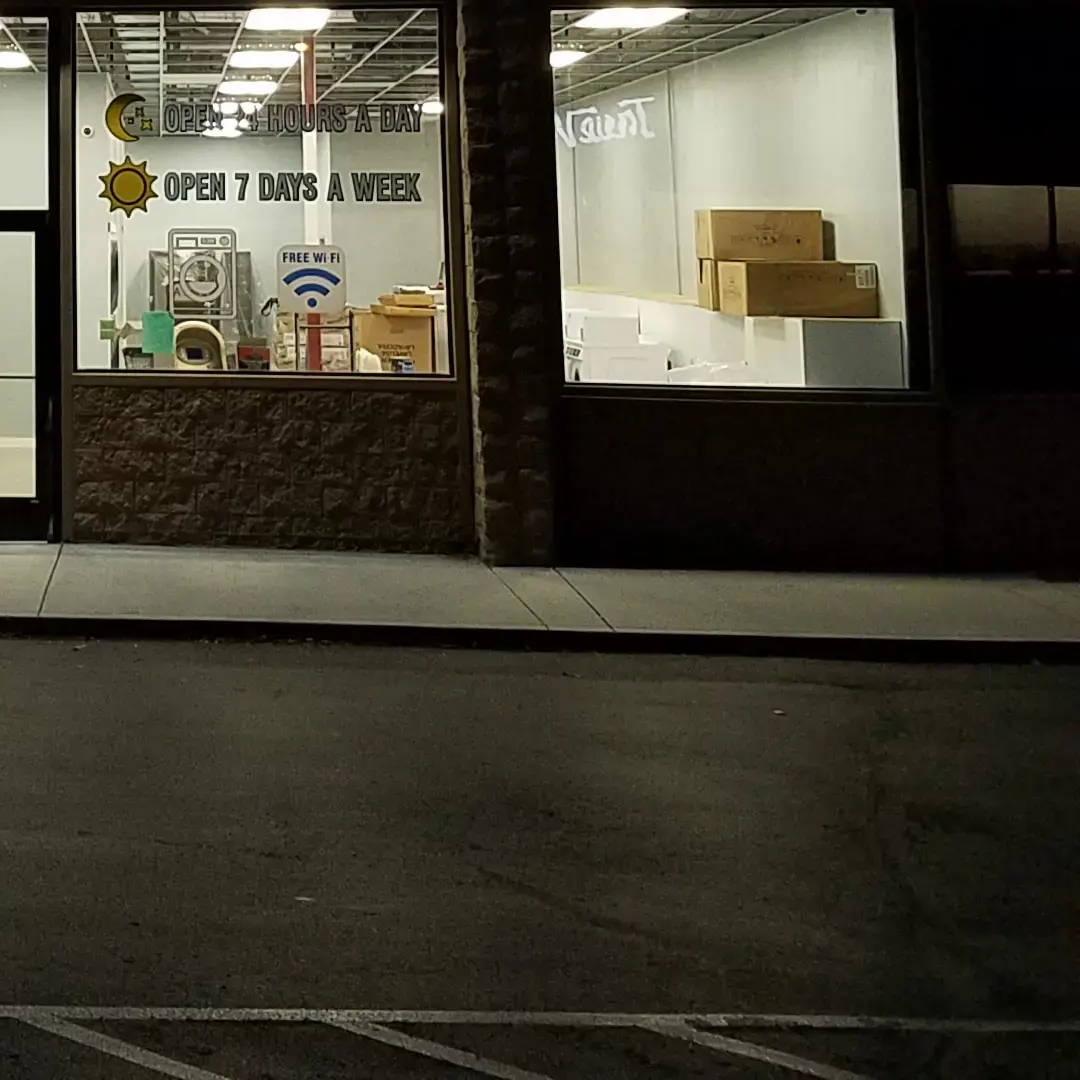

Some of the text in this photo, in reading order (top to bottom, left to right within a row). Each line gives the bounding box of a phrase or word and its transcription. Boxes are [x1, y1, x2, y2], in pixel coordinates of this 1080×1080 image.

[164, 103, 224, 133] OPEN
[267, 103, 347, 133] HOURS
[355, 103, 372, 133] A
[380, 103, 422, 133] DAY
[164, 171, 422, 201] OPEN 7 DAYS A WEEK
[282, 251, 310, 263] FREE
